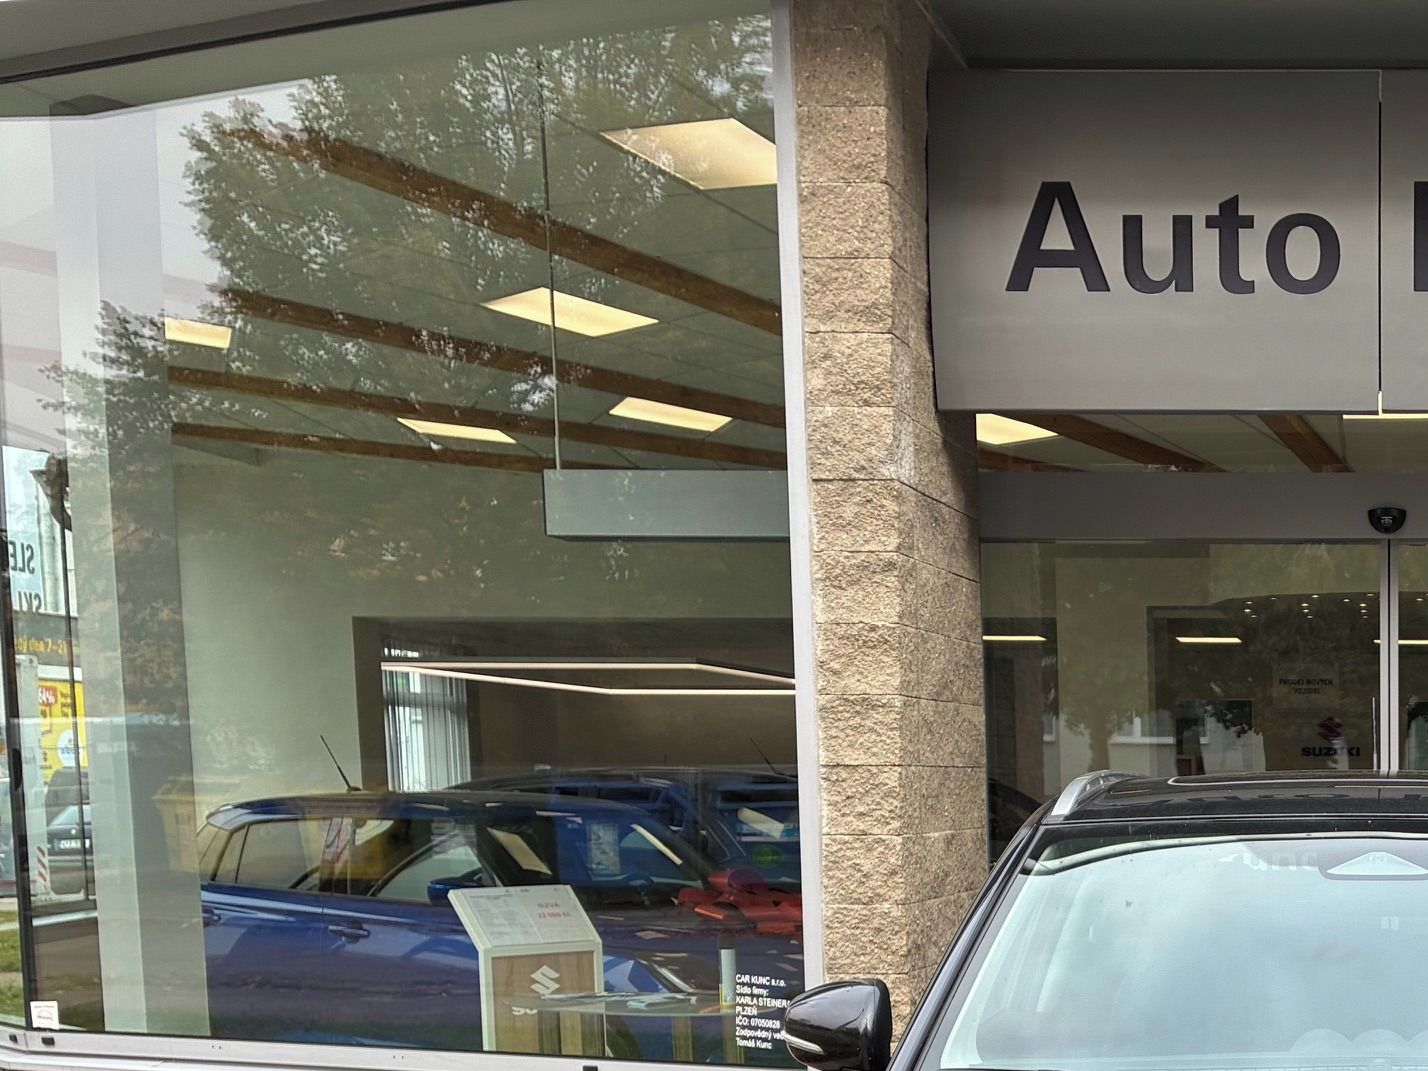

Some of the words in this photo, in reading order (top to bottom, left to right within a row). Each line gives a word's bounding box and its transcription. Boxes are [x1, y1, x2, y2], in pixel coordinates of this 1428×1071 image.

[1005, 180, 1341, 294] Auto
[736, 974, 750, 984] CAR
[751, 975, 770, 985] KUNC
[771, 978, 786, 987] s.r.o.
[736, 996, 757, 1006] KARLA
[756, 1039, 772, 1049] Kunc
